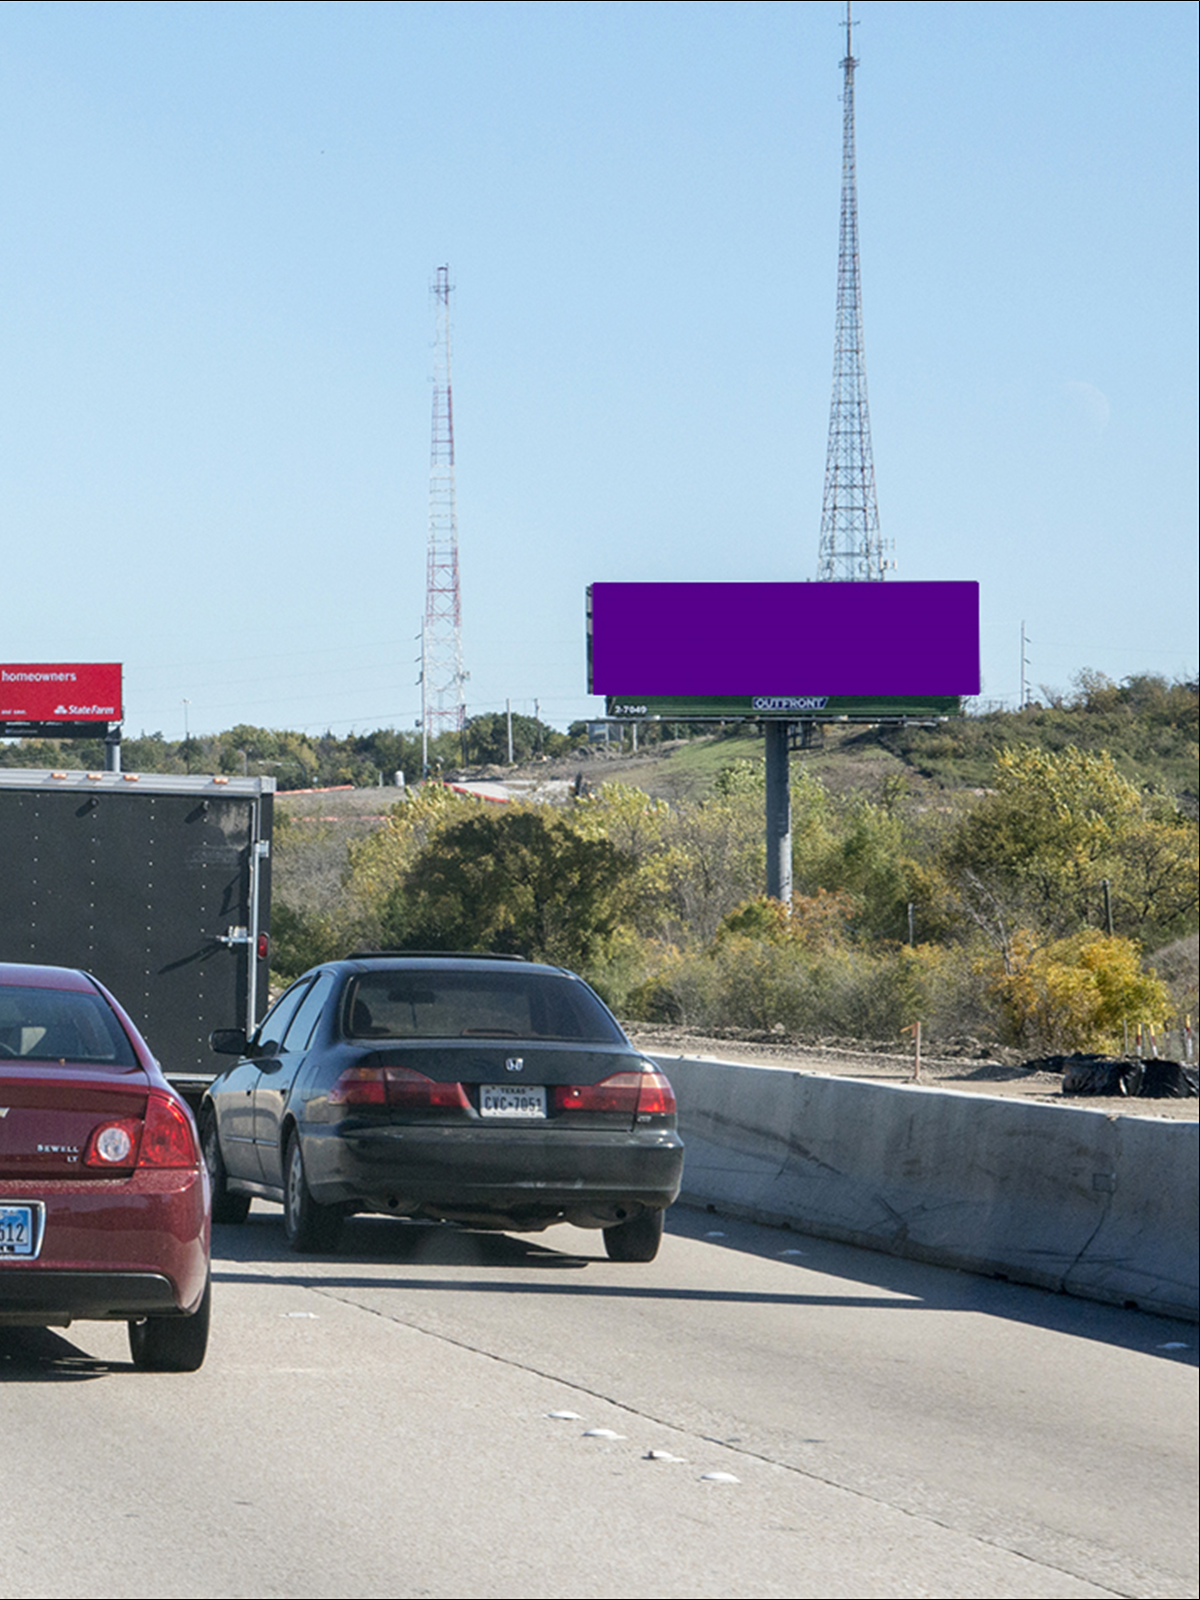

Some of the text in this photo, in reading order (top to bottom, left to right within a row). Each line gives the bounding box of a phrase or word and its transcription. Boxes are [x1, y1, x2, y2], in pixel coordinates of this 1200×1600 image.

[1, 669, 77, 682] homeowners
[755, 697, 823, 709] OUTFRONT
[37, 1144, 79, 1153] SEWELL
[66, 1155, 79, 1163] LT
